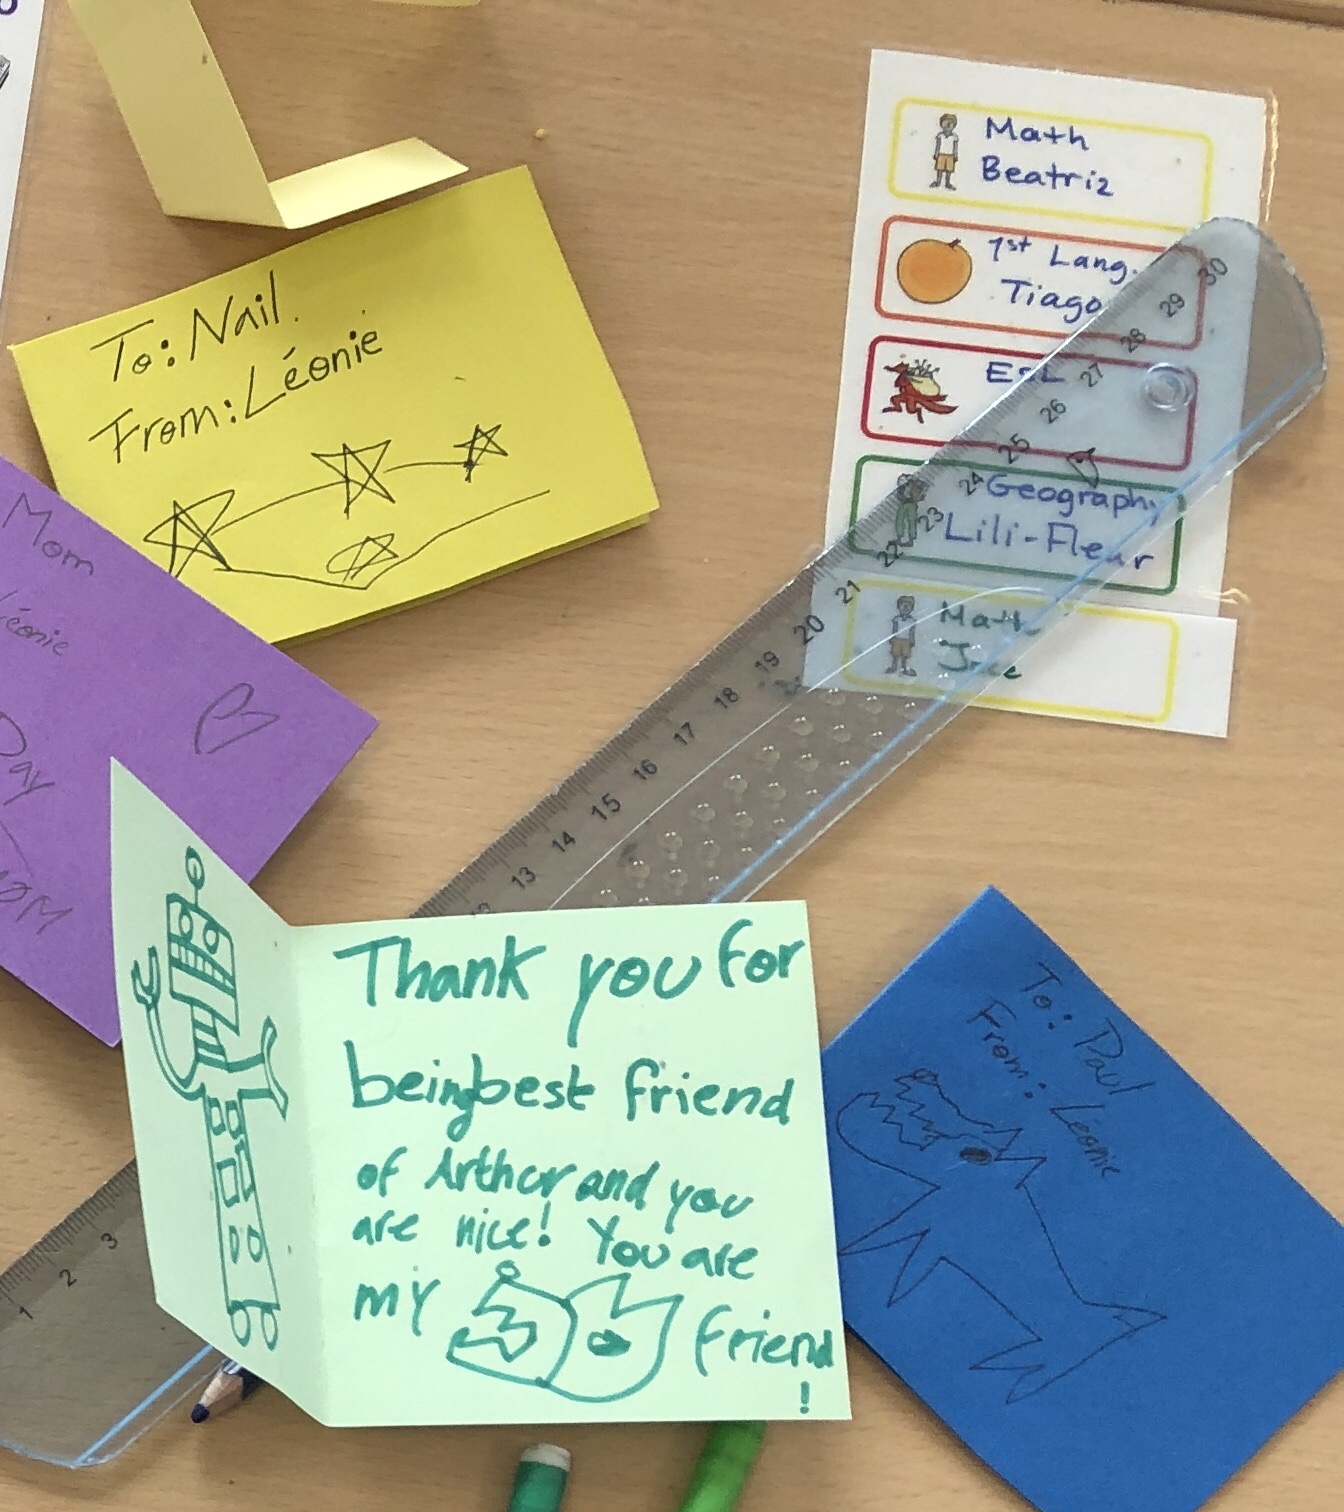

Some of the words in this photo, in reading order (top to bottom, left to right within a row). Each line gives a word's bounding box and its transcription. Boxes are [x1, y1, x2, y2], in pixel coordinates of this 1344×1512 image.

[985, 117, 1090, 151] Math
[981, 155, 1115, 197] Beatriz
[1000, 278, 1104, 323] Tiago
[1158, 291, 1188, 319] 29
[89, 318, 176, 382] To:
[1119, 326, 1148, 354] 28
[1079, 362, 1105, 389] 27
[88, 398, 239, 463] From:
[243, 328, 384, 418] Léonie
[1040, 398, 1068, 425] 26
[2, 492, 96, 578] Mom
[835, 579, 862, 605] 21
[793, 614, 826, 647] 20
[754, 650, 781, 674] 19
[714, 686, 740, 710] 18
[673, 721, 697, 746] 17
[632, 758, 659, 782] 16
[591, 792, 622, 820] 15
[551, 830, 577, 853] 14
[511, 866, 537, 889] 13
[333, 933, 548, 1008] Thank
[566, 953, 703, 1049] you
[1073, 1016, 1157, 1096] Paul
[623, 1057, 796, 1126] friend
[355, 1146, 409, 1199] of
[574, 1161, 661, 1211] and
[668, 1178, 755, 1234] you
[101, 1232, 119, 1253] 3
[351, 1208, 420, 1246] are
[587, 1213, 672, 1270] You
[681, 1245, 760, 1282] are
[58, 1267, 78, 1288] 2
[19, 1304, 34, 1321] 1
[693, 1303, 836, 1378] friend
